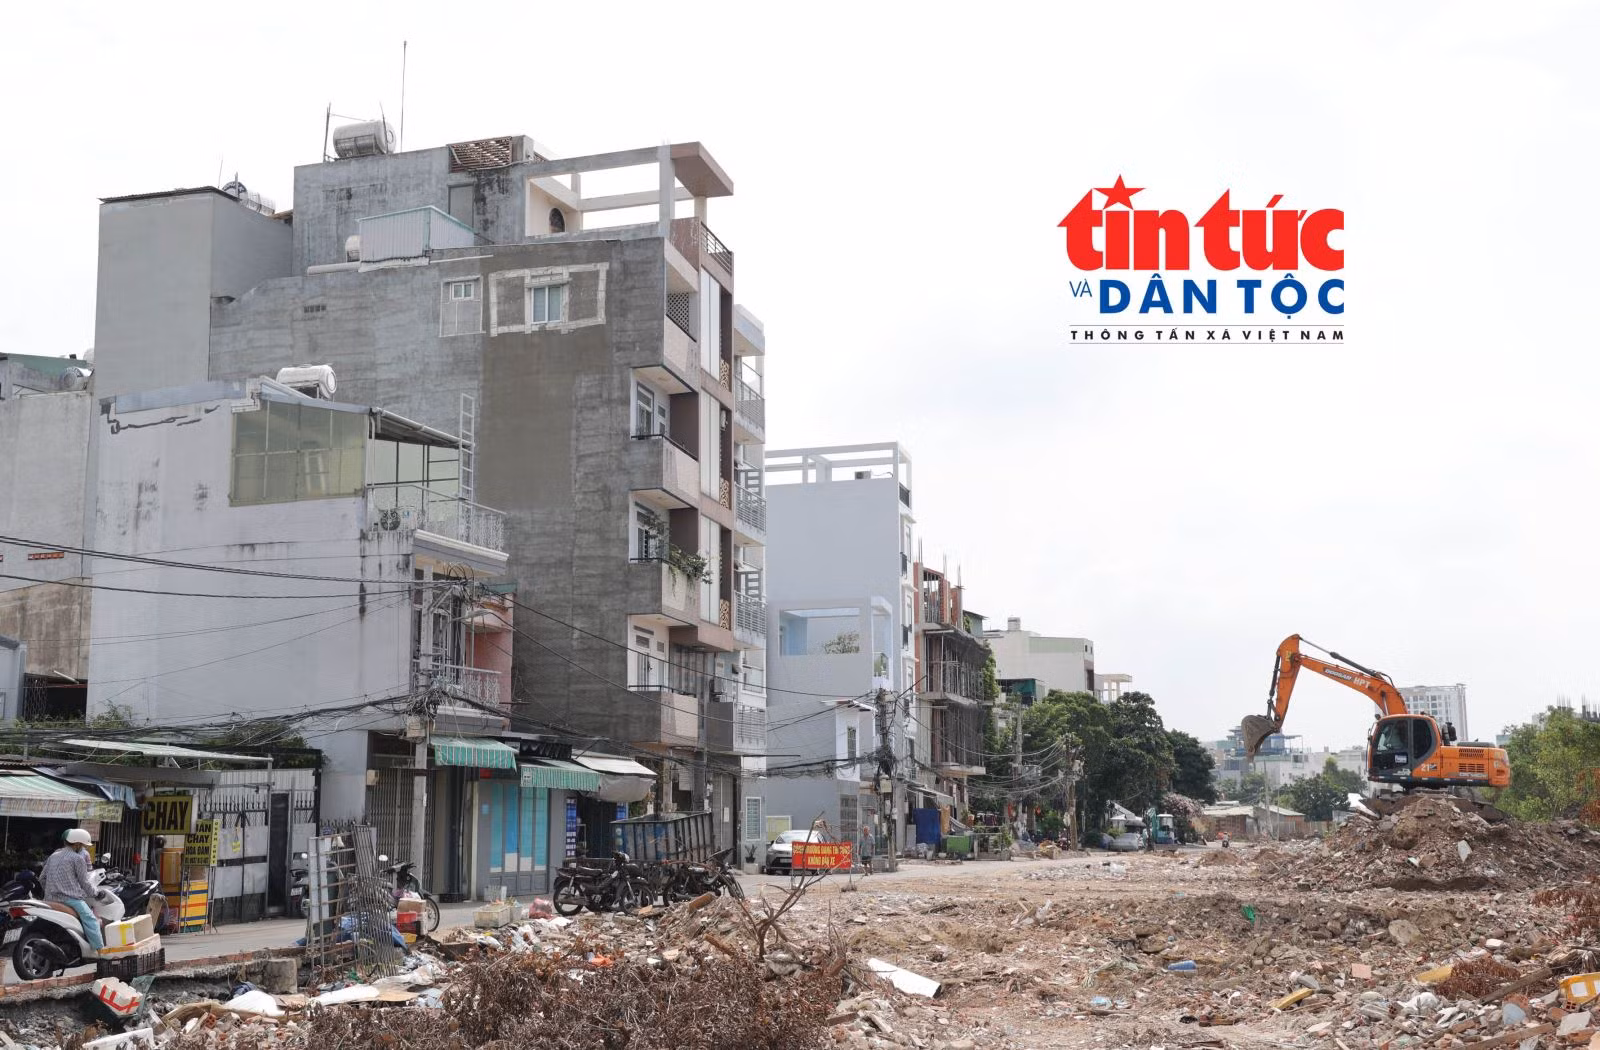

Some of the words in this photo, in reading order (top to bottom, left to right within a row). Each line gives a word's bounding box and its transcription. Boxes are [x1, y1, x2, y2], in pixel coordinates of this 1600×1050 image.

[1353, 676, 1371, 688] HPT
[144, 800, 189, 830] CHAY
[187, 834, 209, 843] CHAY
